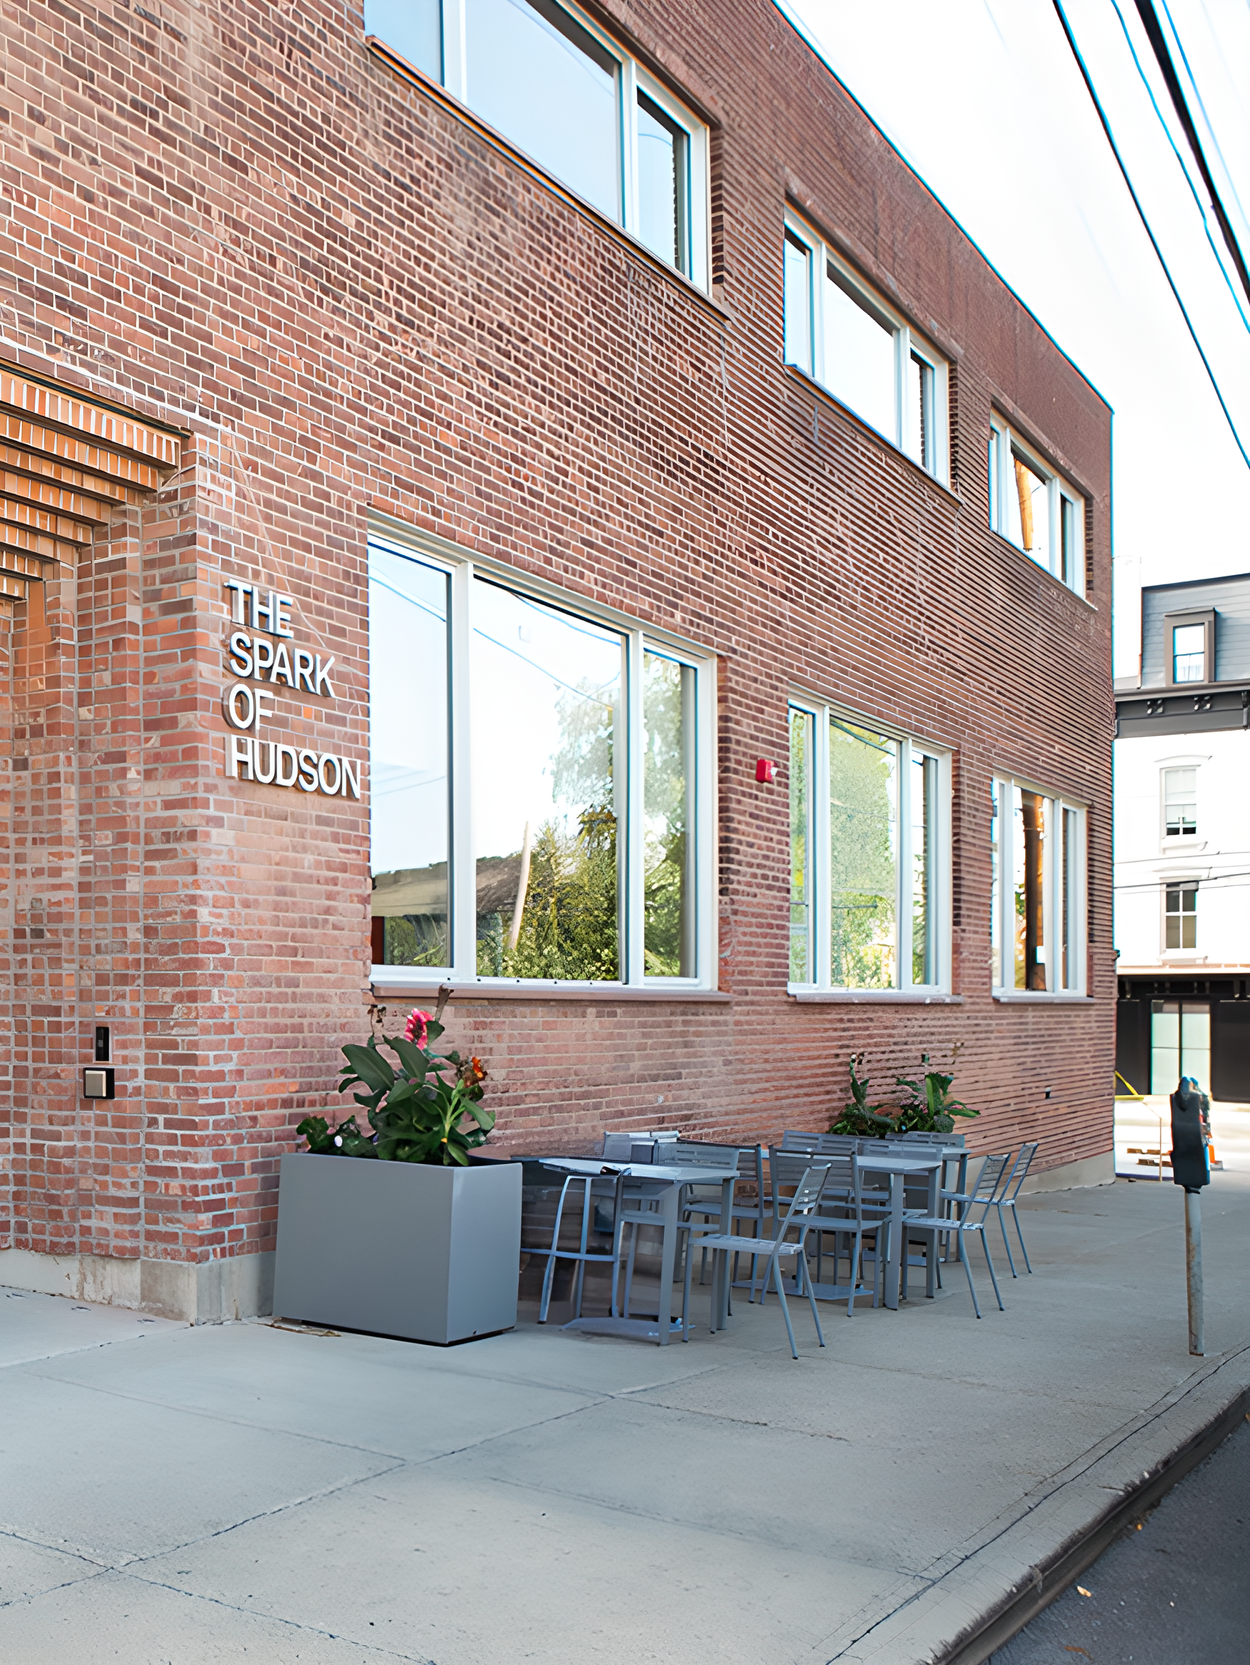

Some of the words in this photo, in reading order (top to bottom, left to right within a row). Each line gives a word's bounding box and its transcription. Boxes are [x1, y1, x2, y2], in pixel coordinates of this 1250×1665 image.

[225, 579, 294, 639] THE
[229, 631, 335, 698] SPARK
[228, 683, 274, 731] OF
[230, 735, 361, 799] HUDSON
